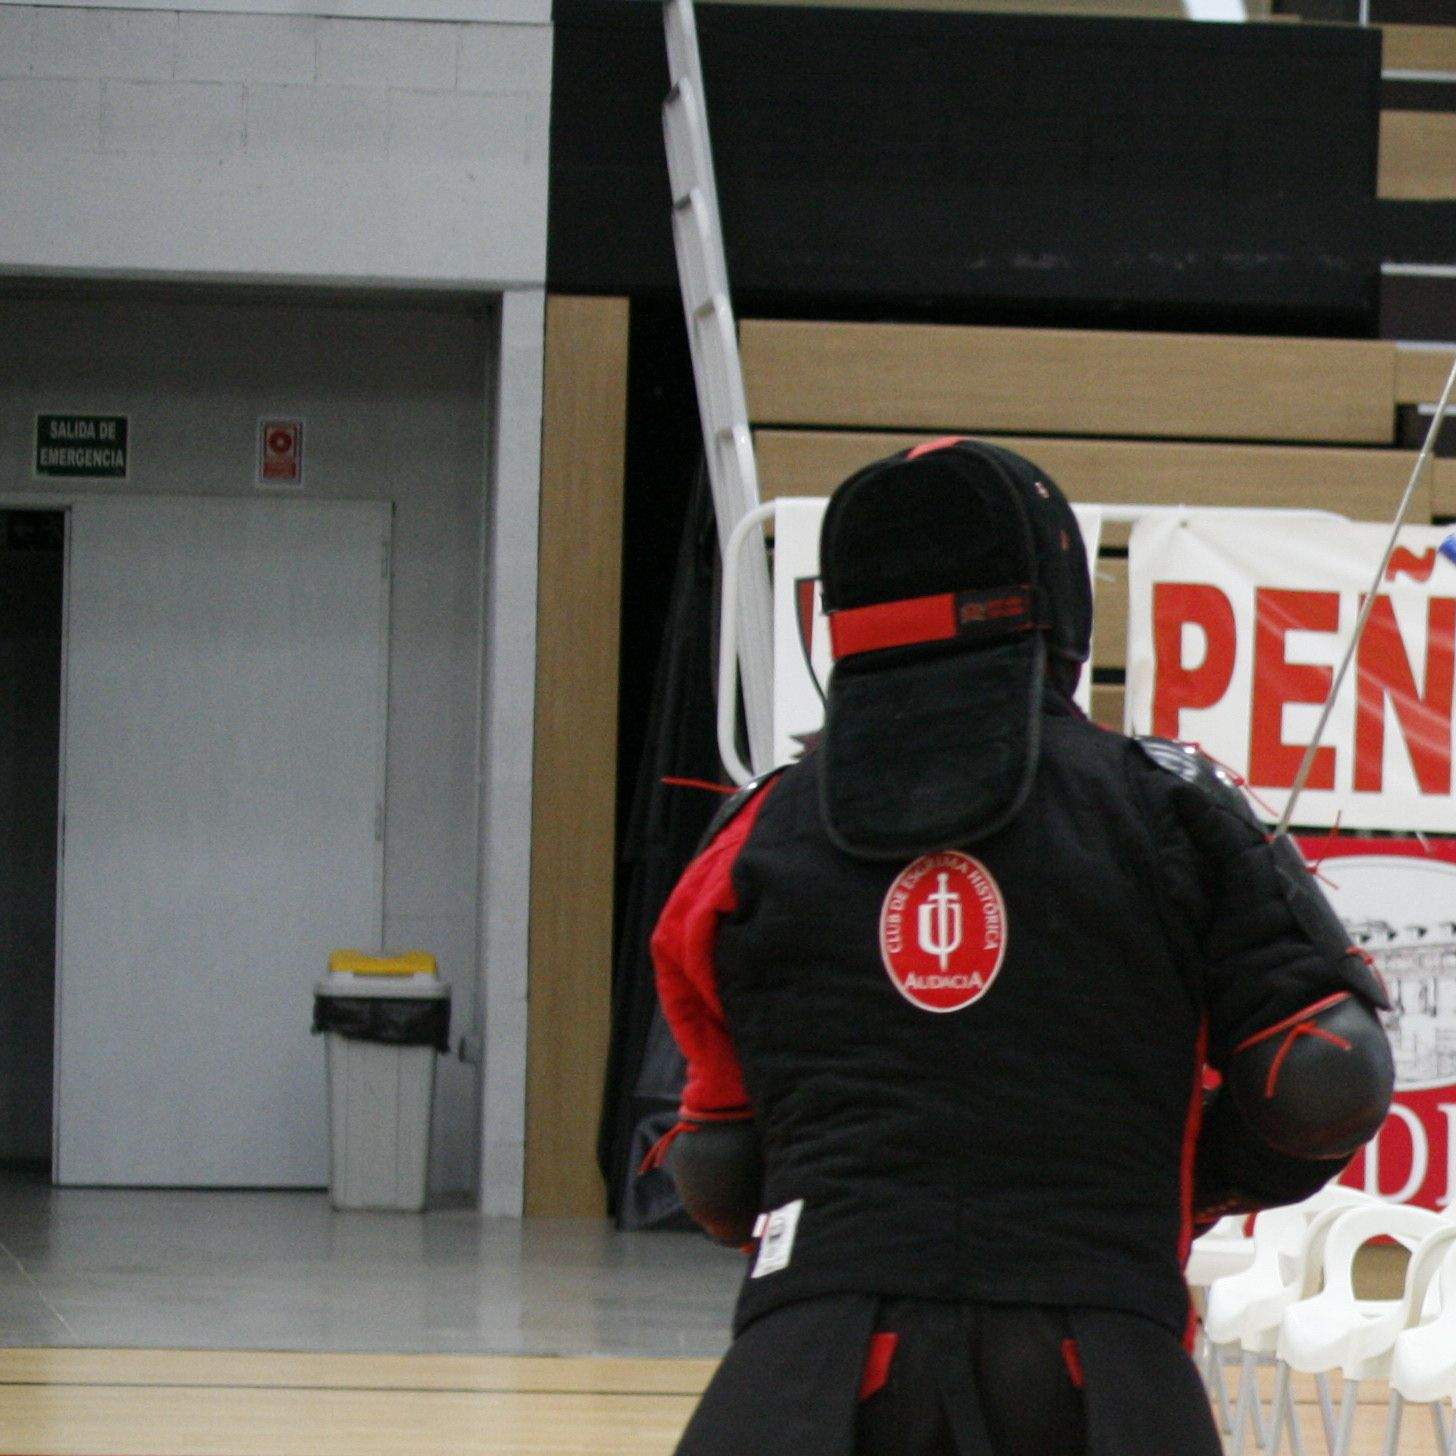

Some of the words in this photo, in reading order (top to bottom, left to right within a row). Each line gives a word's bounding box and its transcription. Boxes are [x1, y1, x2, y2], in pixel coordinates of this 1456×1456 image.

[51, 420, 96, 440] SALIDA
[99, 421, 117, 440] DE
[41, 448, 124, 467] EMERGENCIA
[904, 971, 984, 989] AUDACIA
